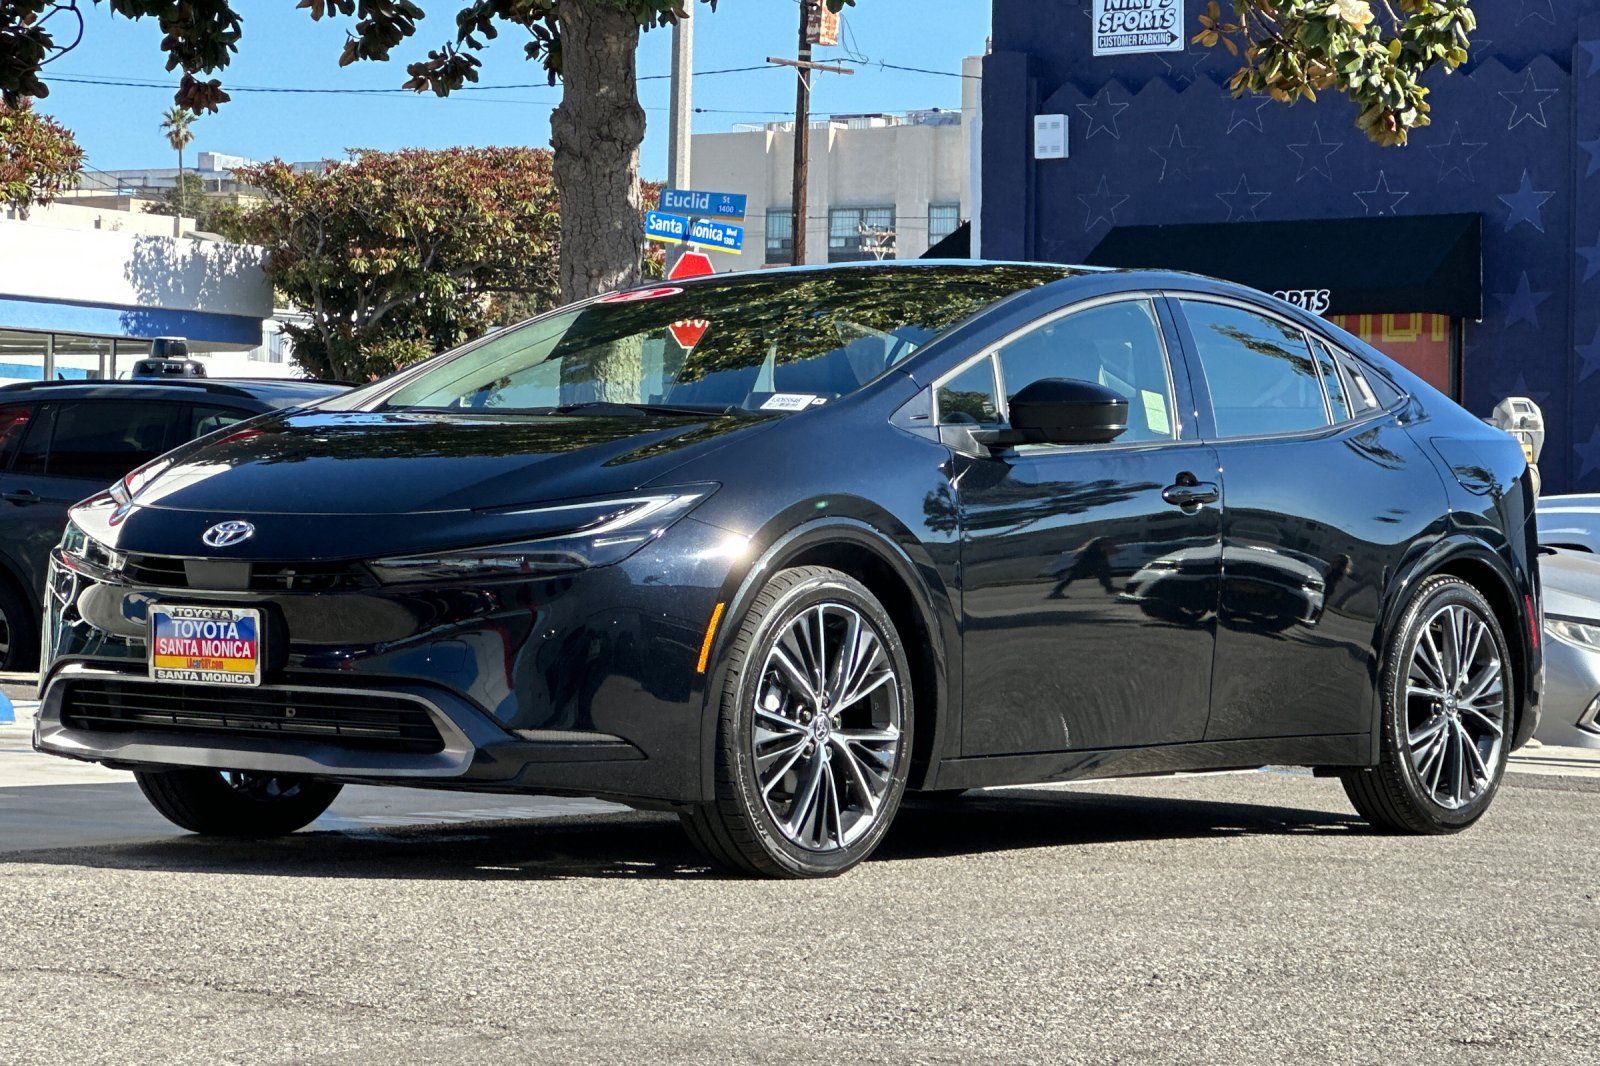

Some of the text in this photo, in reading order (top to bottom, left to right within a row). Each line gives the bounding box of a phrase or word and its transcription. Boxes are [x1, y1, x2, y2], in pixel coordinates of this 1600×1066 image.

[1097, 8, 1176, 34] SPORTS
[1099, 33, 1171, 48] CUSTOMER PARKING
[664, 191, 711, 210] Euclid
[722, 195, 731, 204] St
[719, 205, 734, 213] 1400
[648, 213, 723, 242] Santa Monica
[726, 227, 738, 237] Blvd
[175, 608, 230, 620] TOYOTA
[171, 620, 240, 640] TOYOTA
[159, 638, 252, 658] SANTA MONICA
[157, 670, 252, 684] SANTA MONICA
